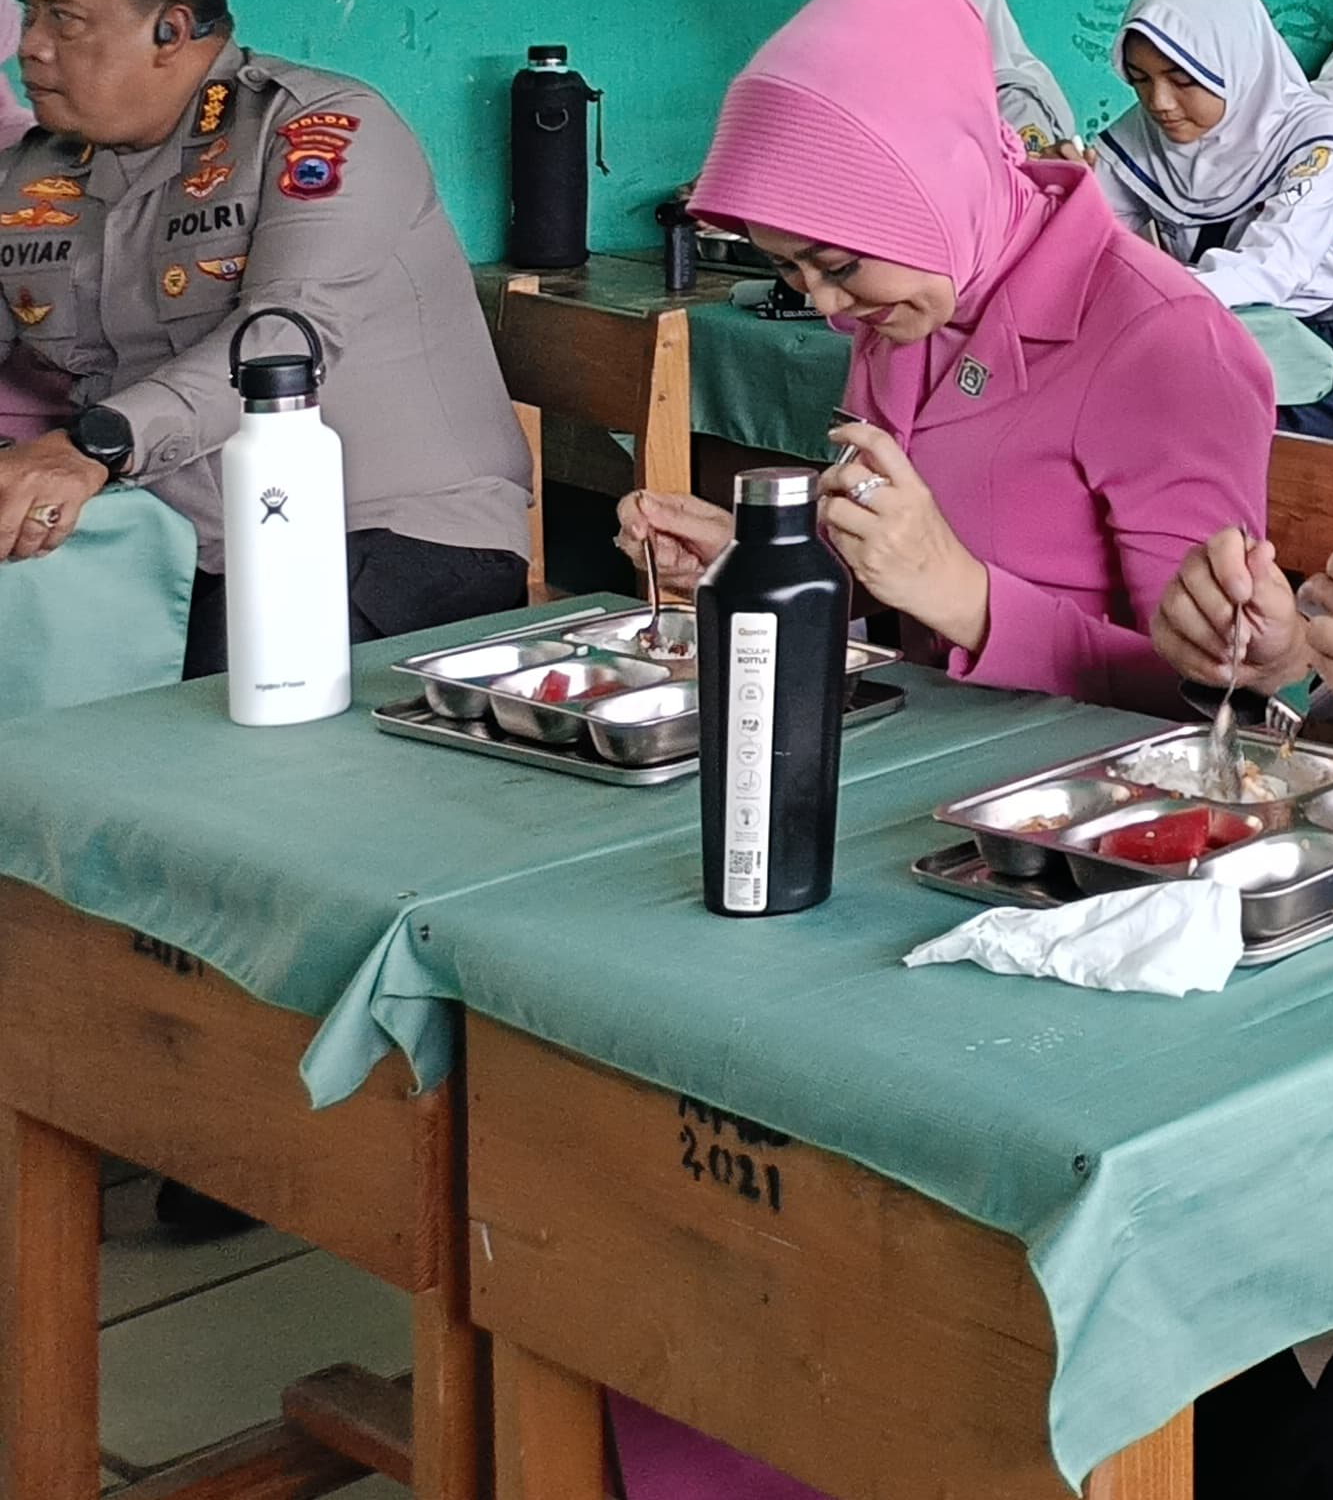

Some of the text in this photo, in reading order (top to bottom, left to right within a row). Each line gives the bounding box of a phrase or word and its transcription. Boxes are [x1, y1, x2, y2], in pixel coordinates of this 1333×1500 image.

[166, 202, 246, 243] POLRI
[0, 239, 72, 268] OVIAR
[679, 1123, 781, 1214] 2021
